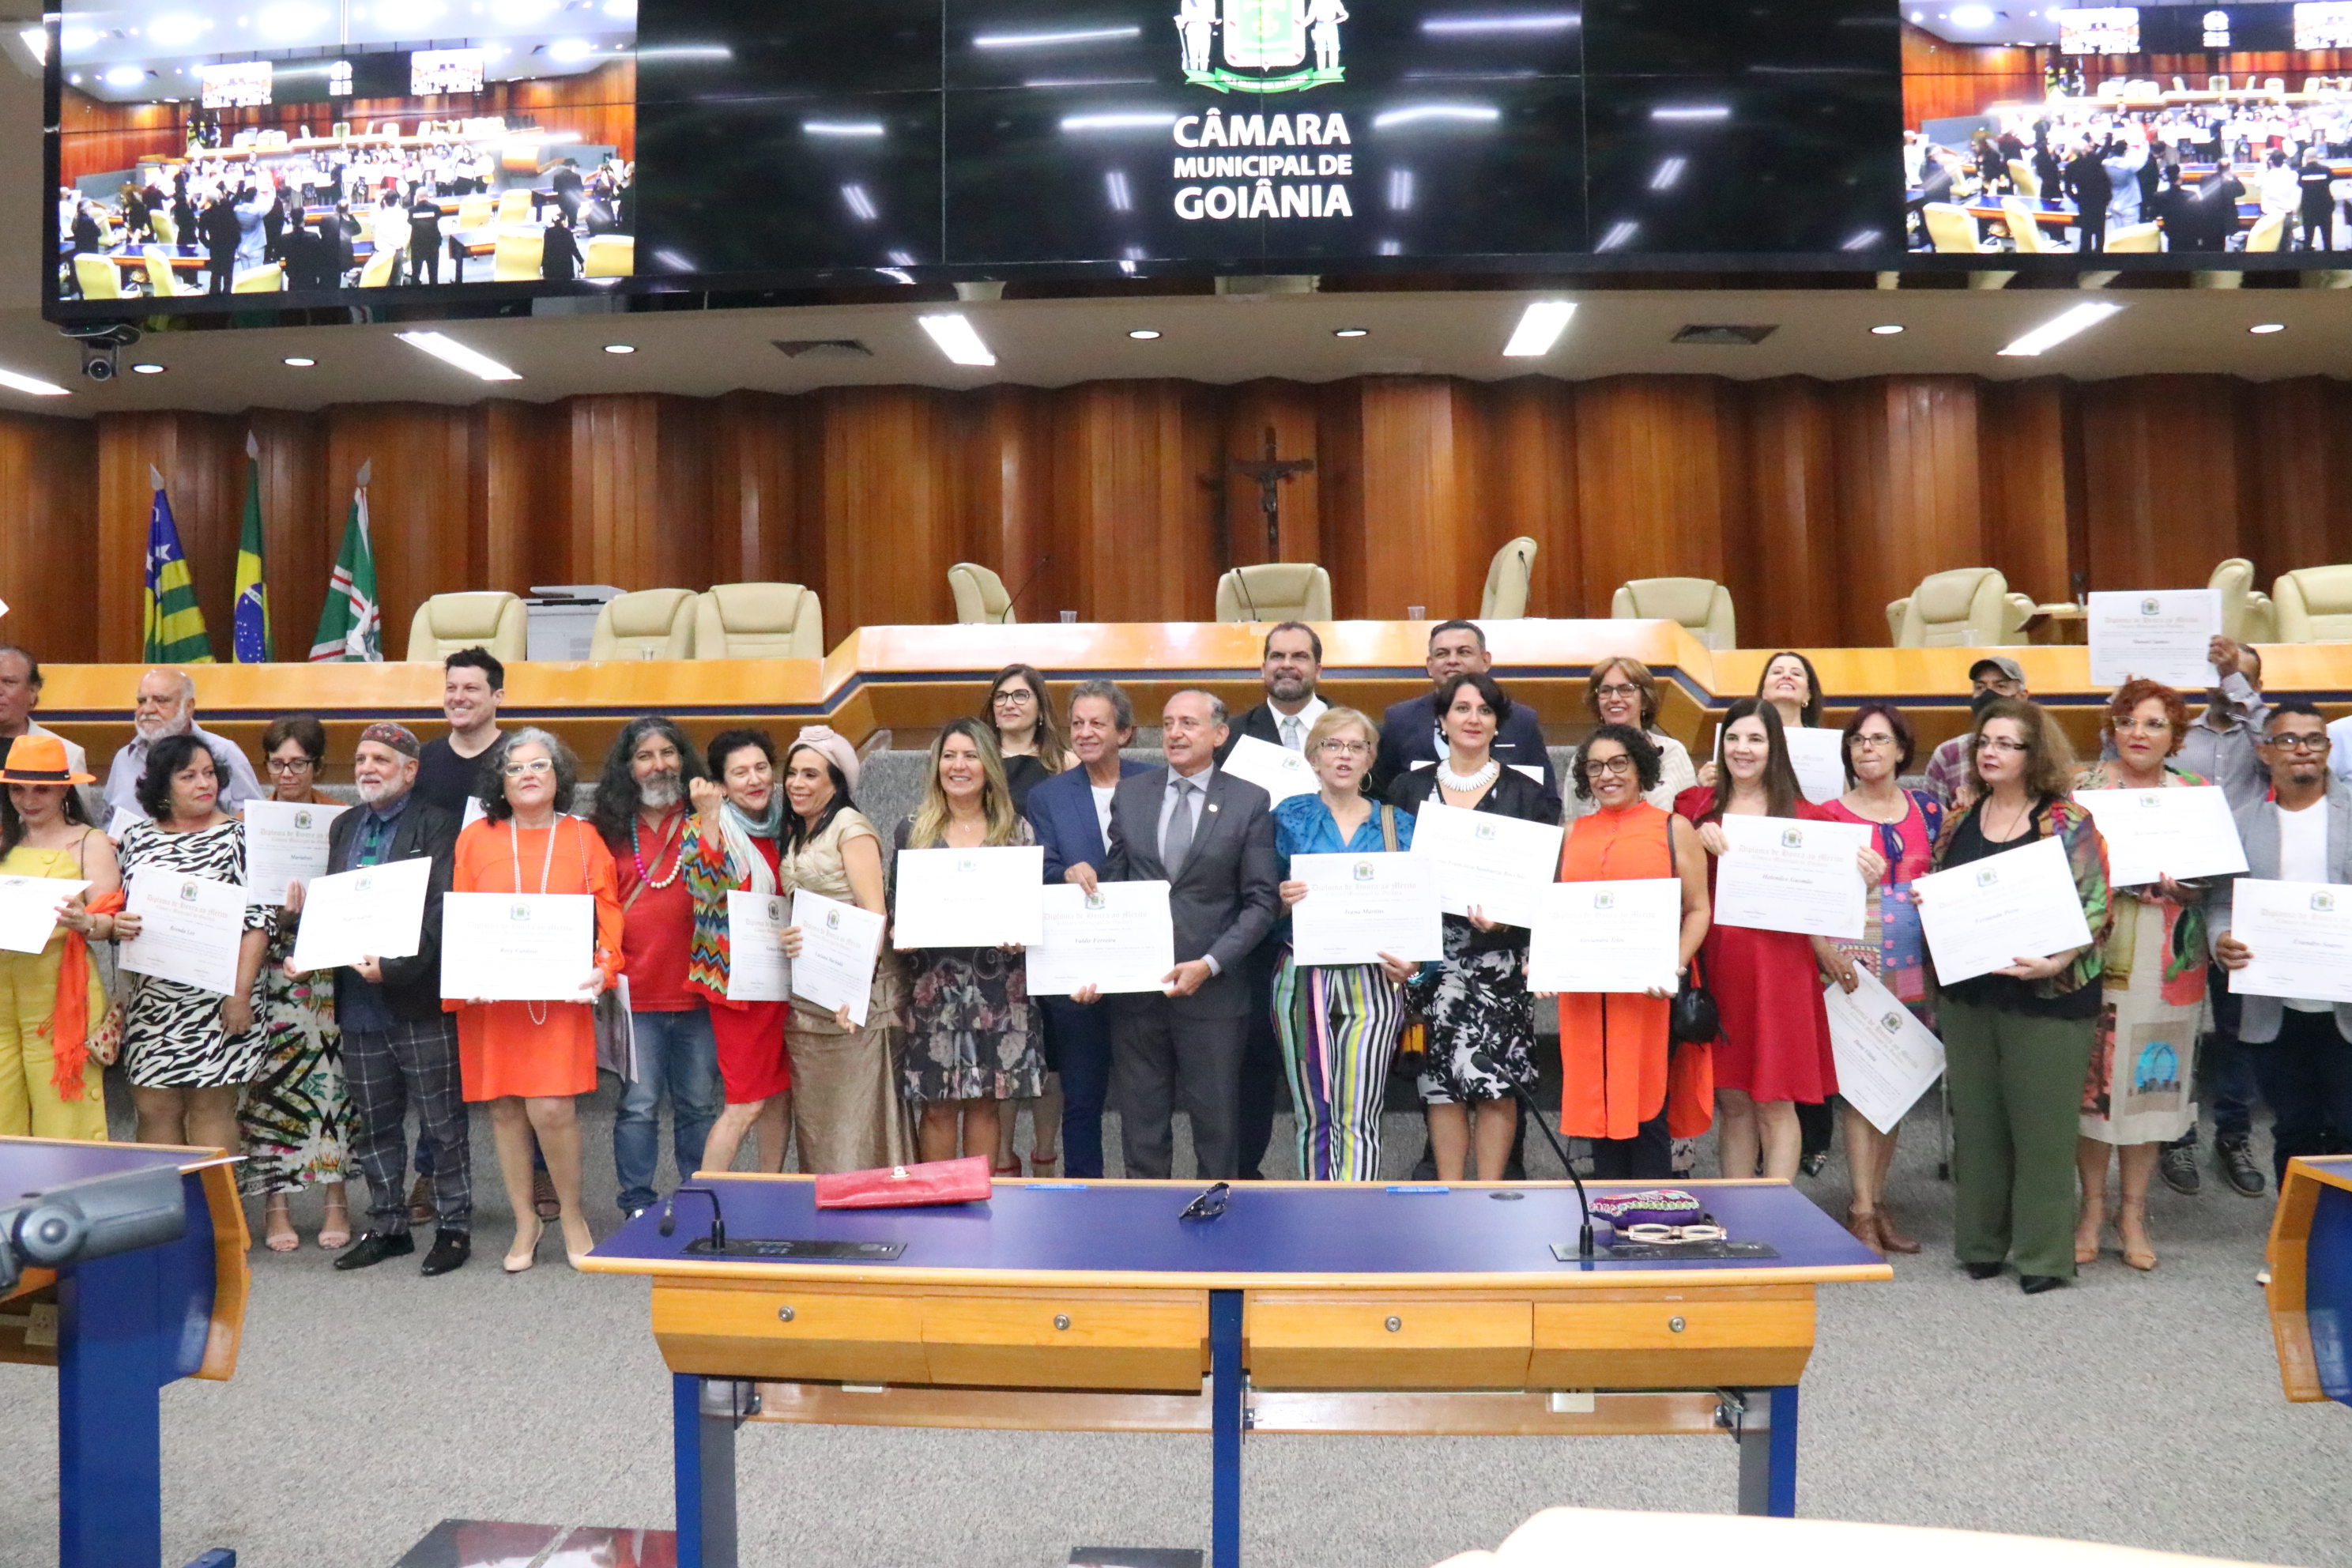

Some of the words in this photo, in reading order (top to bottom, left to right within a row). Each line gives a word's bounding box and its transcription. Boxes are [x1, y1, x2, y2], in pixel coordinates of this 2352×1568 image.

[1174, 107, 1351, 148] CÂMARA
[1174, 156, 1314, 178] MUNICIPAL
[1319, 154, 1352, 175] DE
[1174, 178, 1352, 220] GOIÂNIA
[147, 894, 170, 906] Diploma
